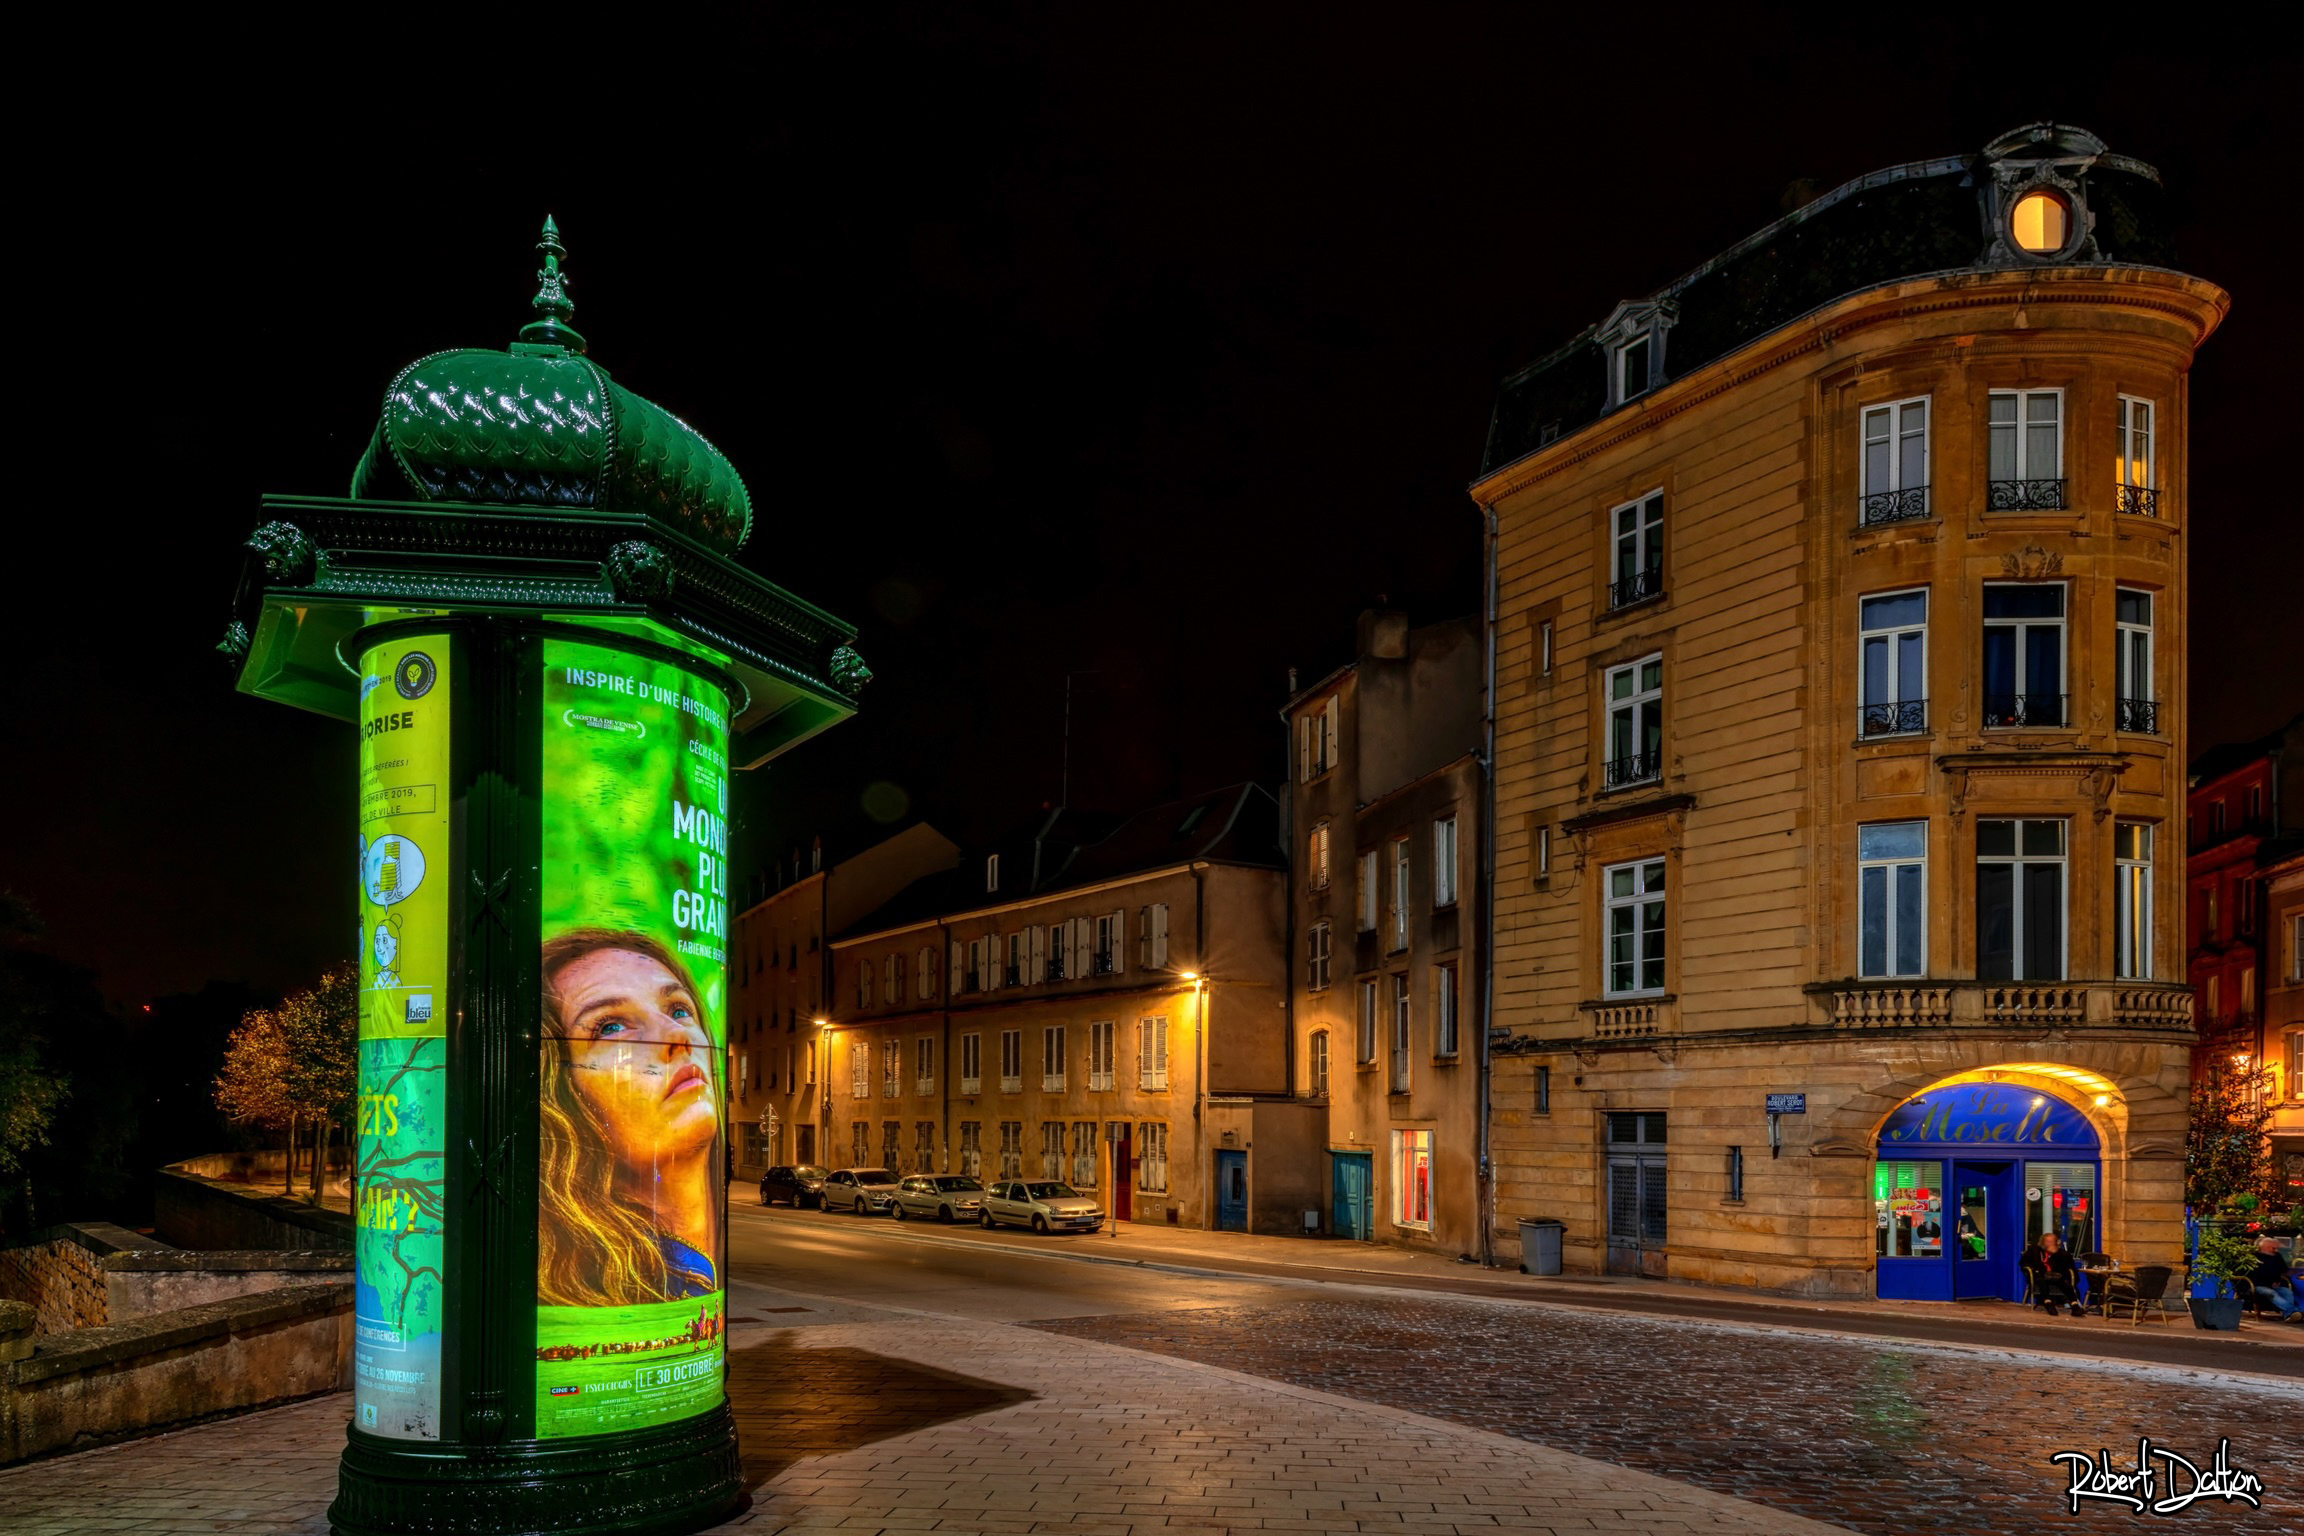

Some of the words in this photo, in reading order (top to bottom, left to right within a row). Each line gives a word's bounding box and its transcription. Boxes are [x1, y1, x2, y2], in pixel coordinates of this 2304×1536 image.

[566, 667, 634, 695] INSPIRÉ
[639, 681, 679, 708] D'UNE
[682, 695, 720, 729] HISTOIRE
[572, 713, 603, 723] MOSTRA
[689, 739, 712, 761] CÉCILE
[378, 805, 401, 816] VILLE
[674, 800, 727, 861] MOND
[699, 851, 727, 901] PLU
[673, 889, 727, 941] GRAN
[678, 940, 712, 959] FABIENNE
[409, 1008, 431, 1018] bleu
[1968, 1090, 2008, 1115] La
[1891, 1101, 2066, 1143] Moselle
[364, 1326, 401, 1343] CONFÉRENCES
[376, 1367, 385, 1380] 26
[385, 1368, 426, 1385] NOVEMBRE
[640, 1371, 653, 1387] LE
[657, 1367, 671, 1385] 30
[674, 1357, 713, 1382] OCTOBRE
